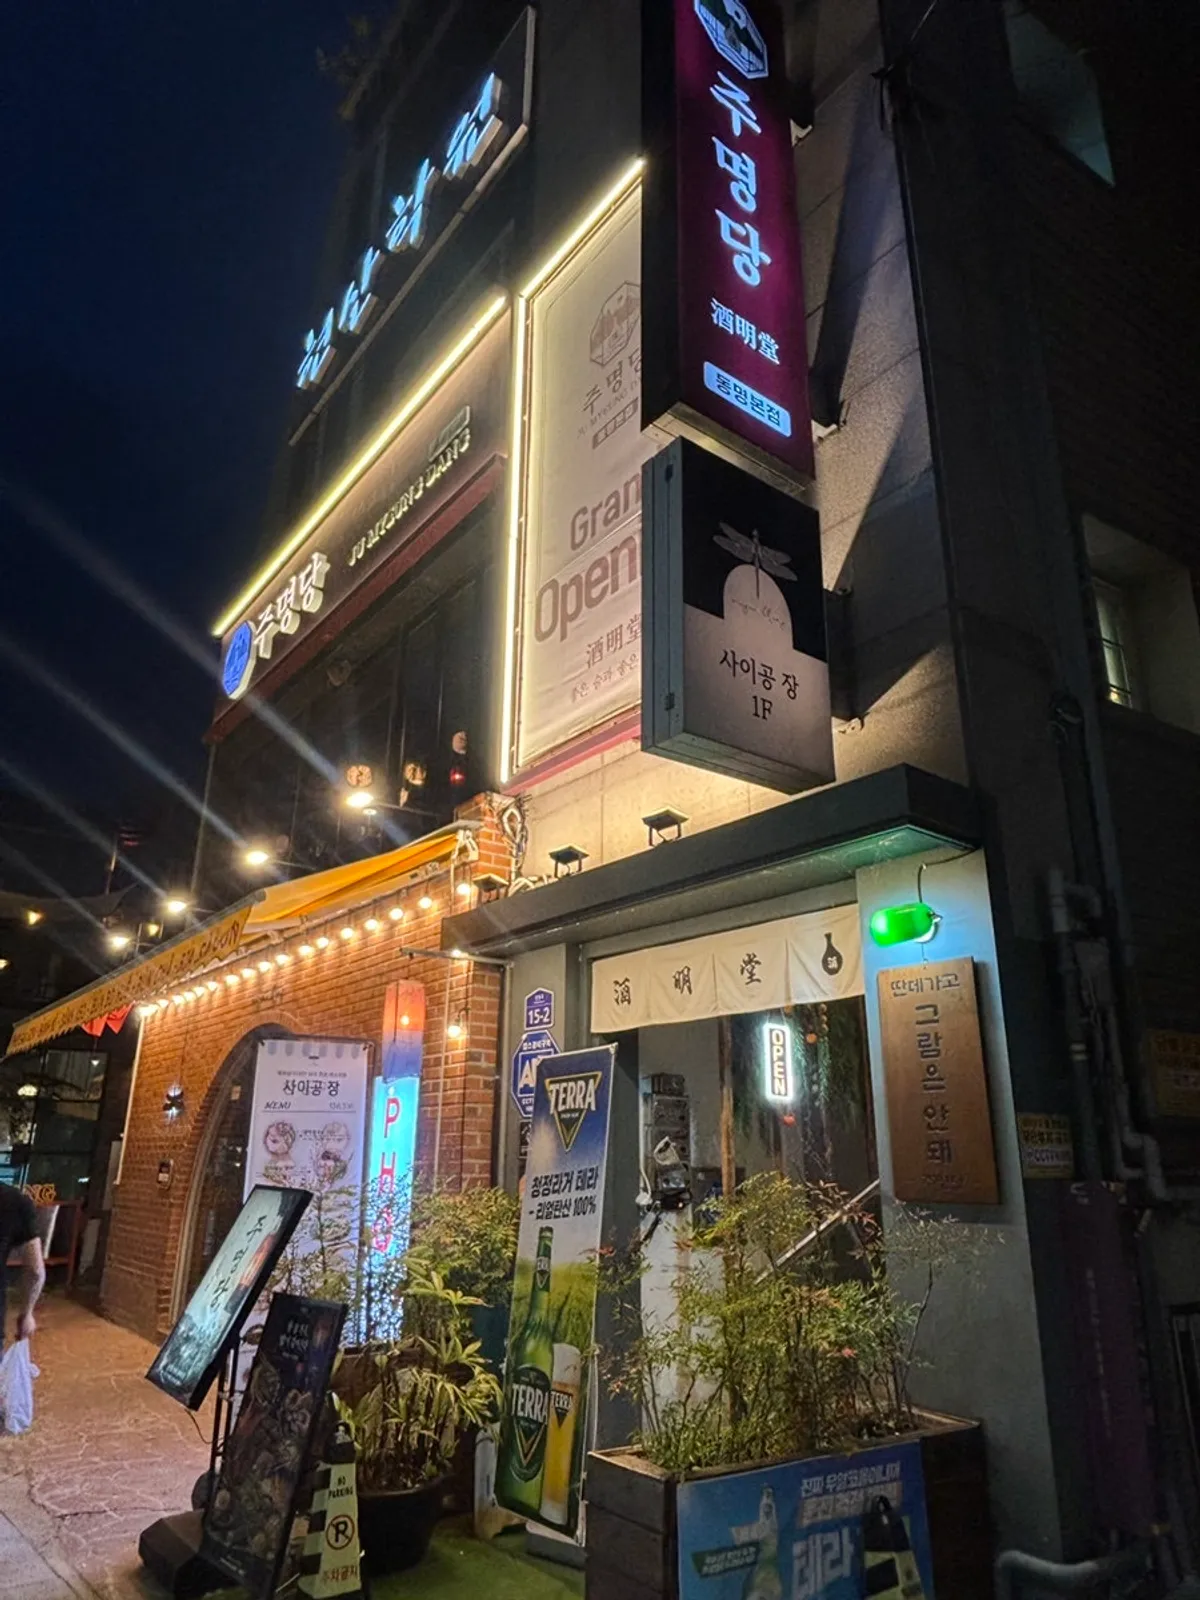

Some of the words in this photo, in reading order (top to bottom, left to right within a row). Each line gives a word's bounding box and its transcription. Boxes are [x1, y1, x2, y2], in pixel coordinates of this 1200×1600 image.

[709, 71, 773, 287] 주명당
[710, 297, 781, 366] 酒明堂
[254, 551, 331, 660] 주명당
[534, 532, 641, 643] Open
[751, 695, 773, 721] 1F
[527, 1007, 551, 1025] 15-2
[771, 1029, 786, 1097] OPEN
[549, 1076, 597, 1117] TERRA
[531, 1171, 575, 1199] 청정라거
[575, 1166, 599, 1191] 테라
[572, 1195, 597, 1217] 100%
[511, 1383, 548, 1425] TERRA
[550, 1390, 573, 1411] TERRA
